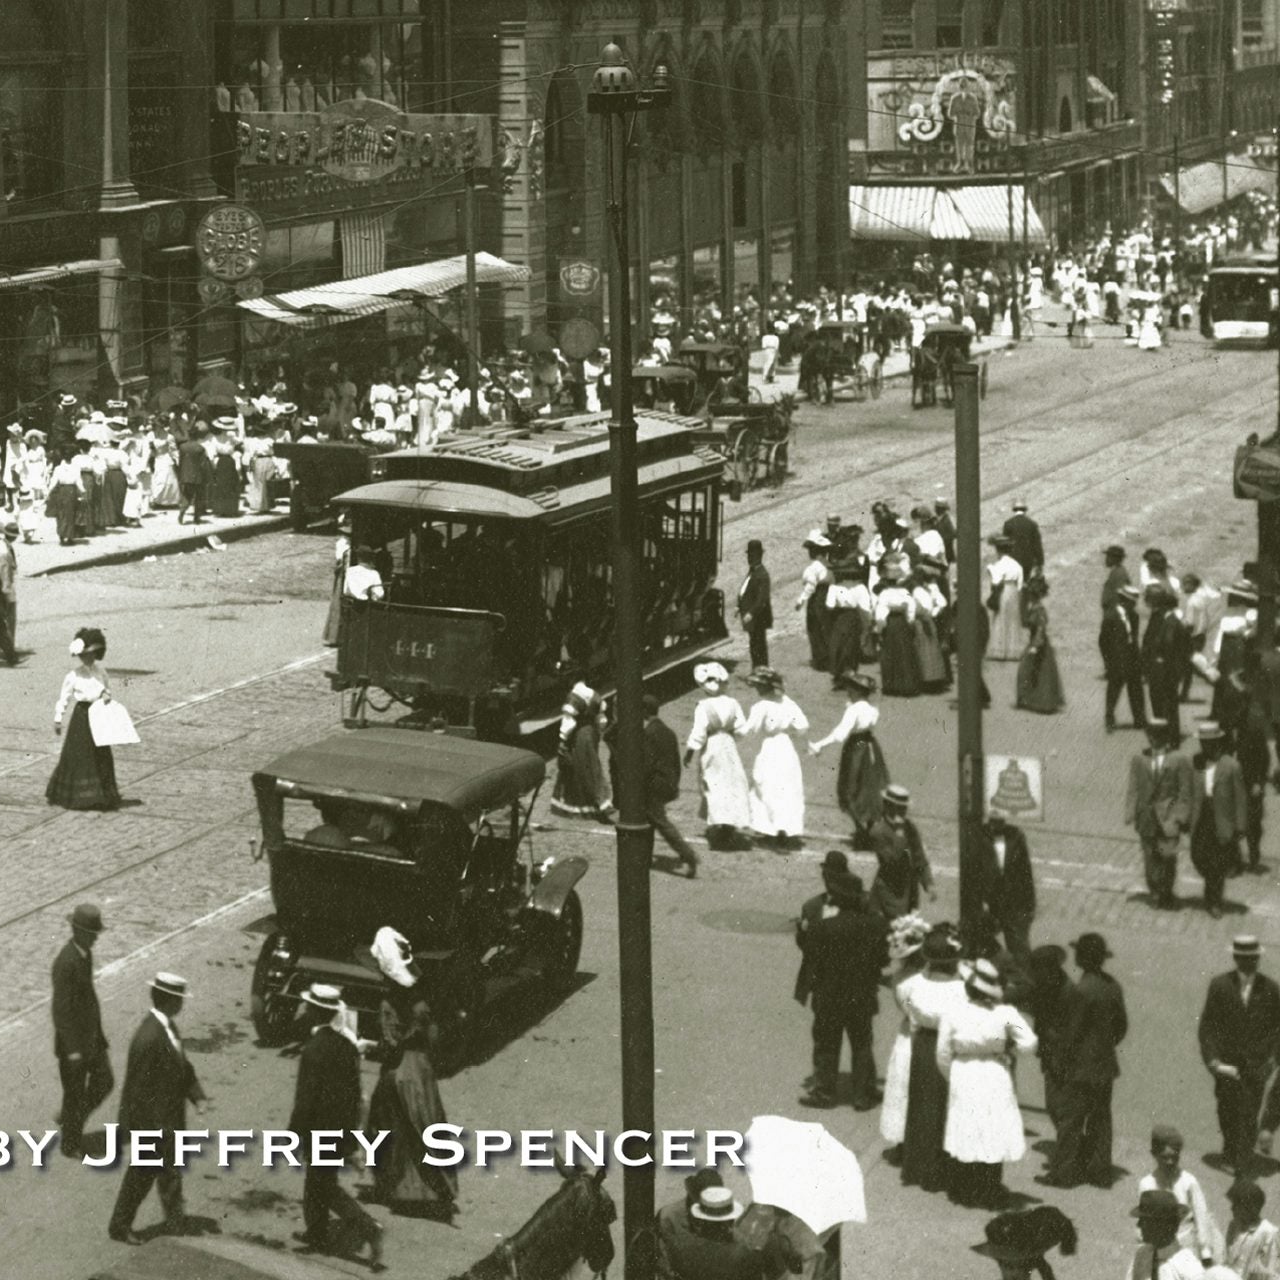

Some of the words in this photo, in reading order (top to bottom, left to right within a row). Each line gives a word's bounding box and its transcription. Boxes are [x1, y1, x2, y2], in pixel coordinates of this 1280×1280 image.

[380, 124, 478, 166] STORE
[215, 210, 246, 221] EYES
[204, 227, 261, 256] GLOBE
